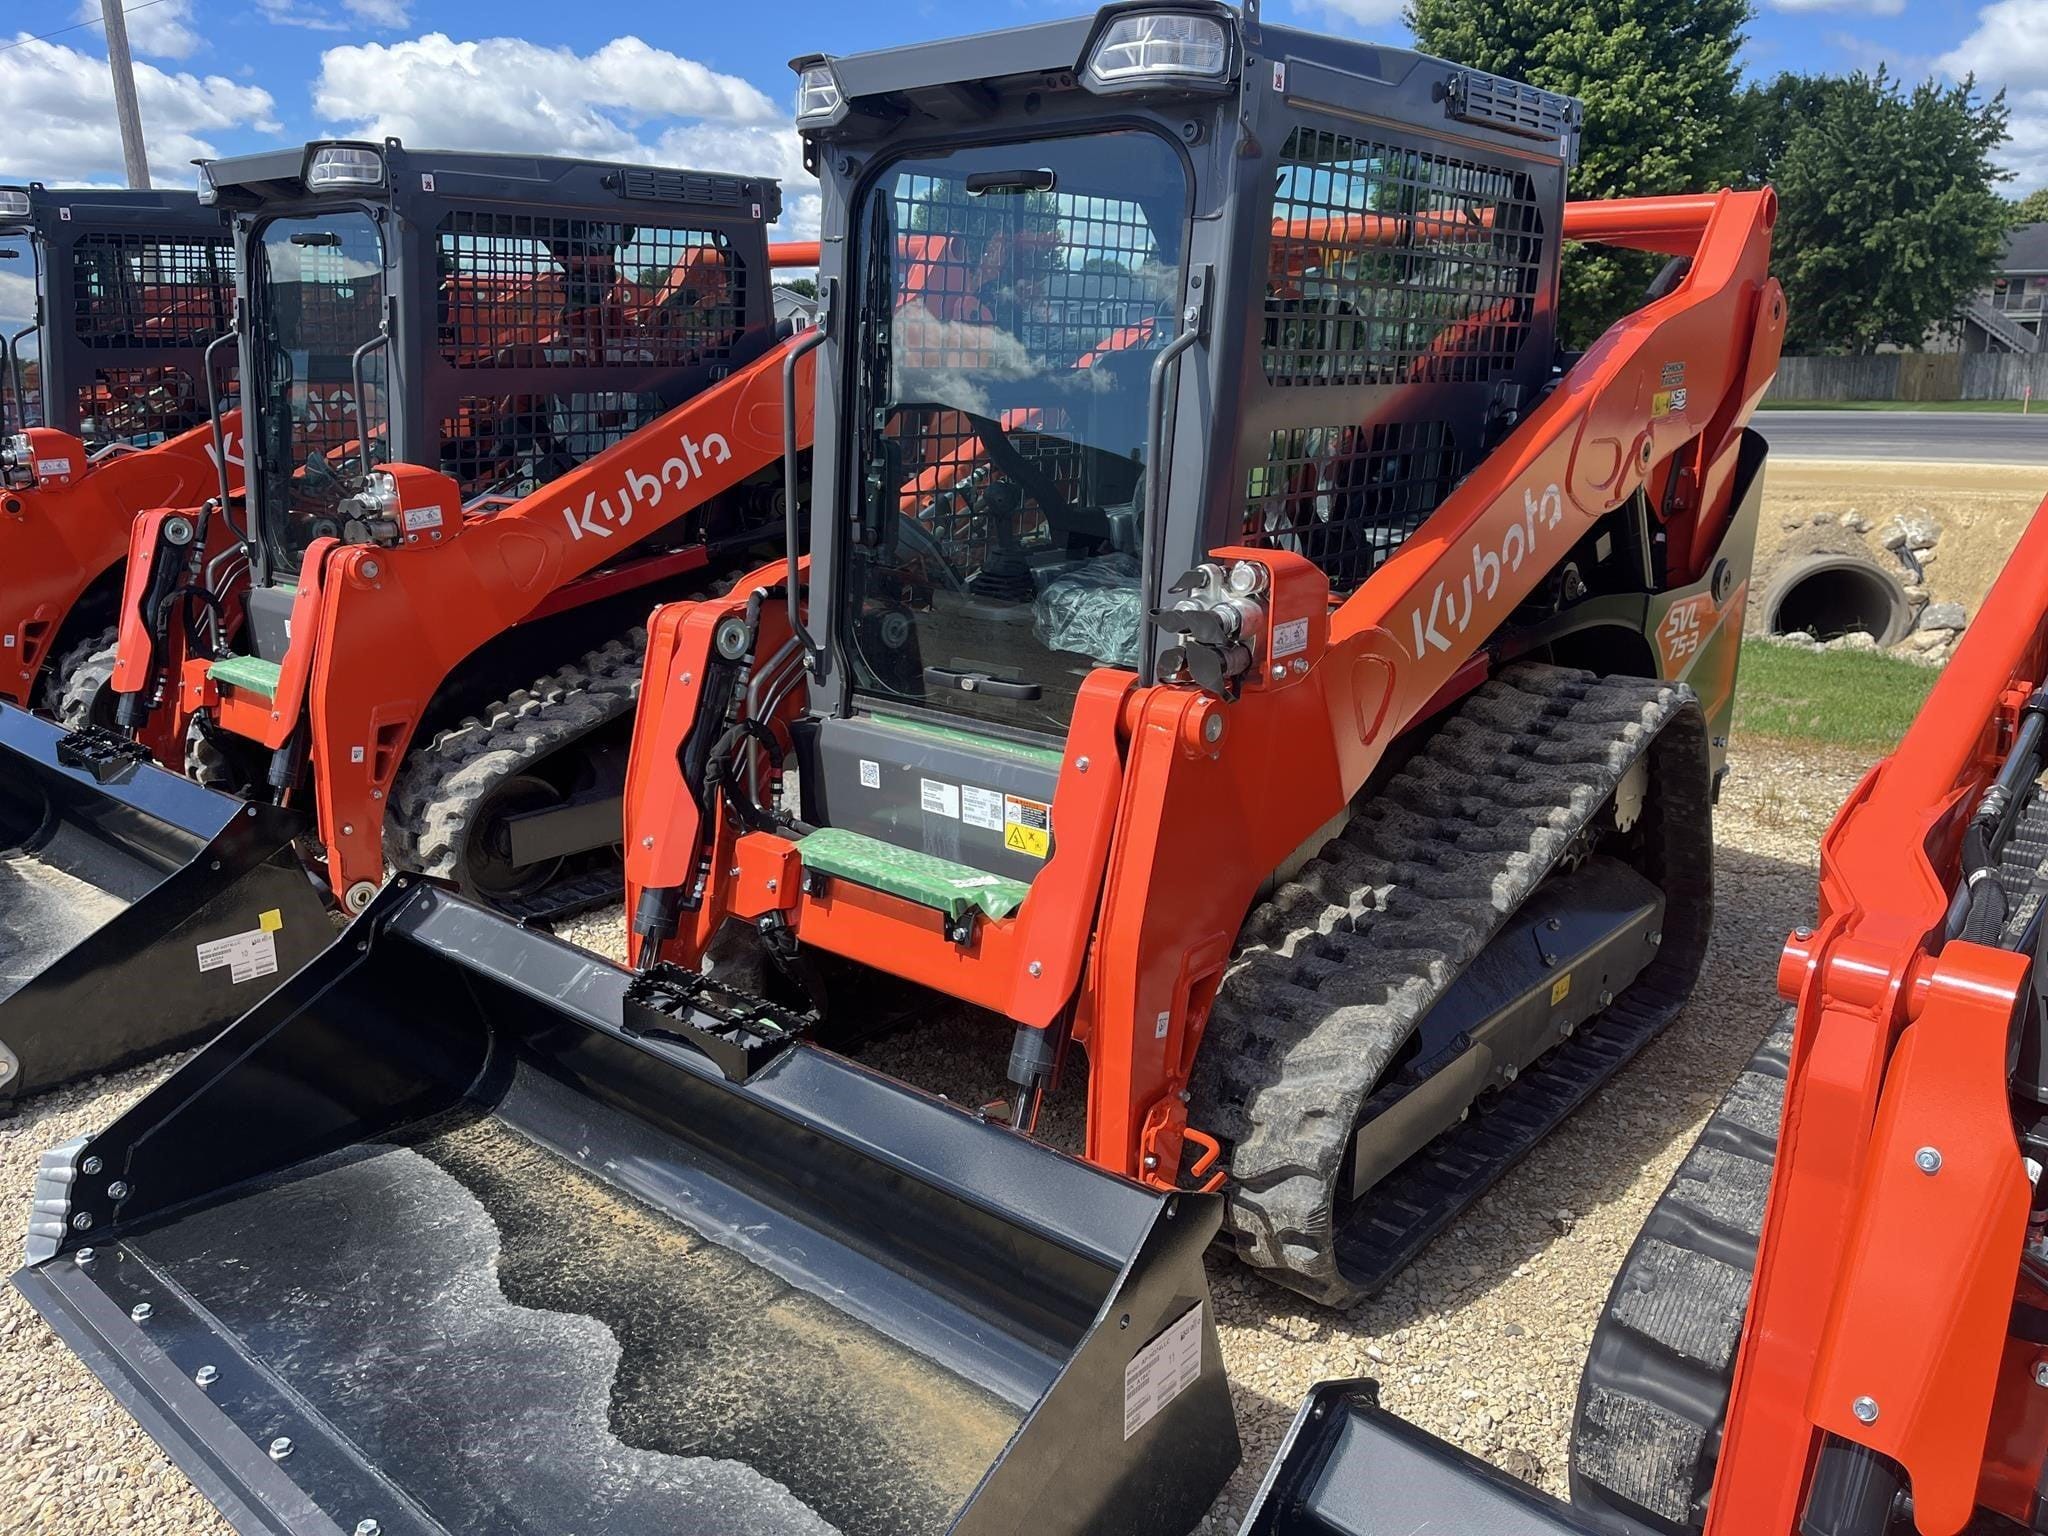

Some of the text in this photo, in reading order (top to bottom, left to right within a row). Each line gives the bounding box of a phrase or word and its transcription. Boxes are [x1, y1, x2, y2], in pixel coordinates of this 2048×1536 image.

[562, 432, 732, 541] Kubota
[1412, 483, 1562, 660] Kubota
[1665, 602, 1700, 638] SVL
[1668, 631, 1699, 661] 75-3
